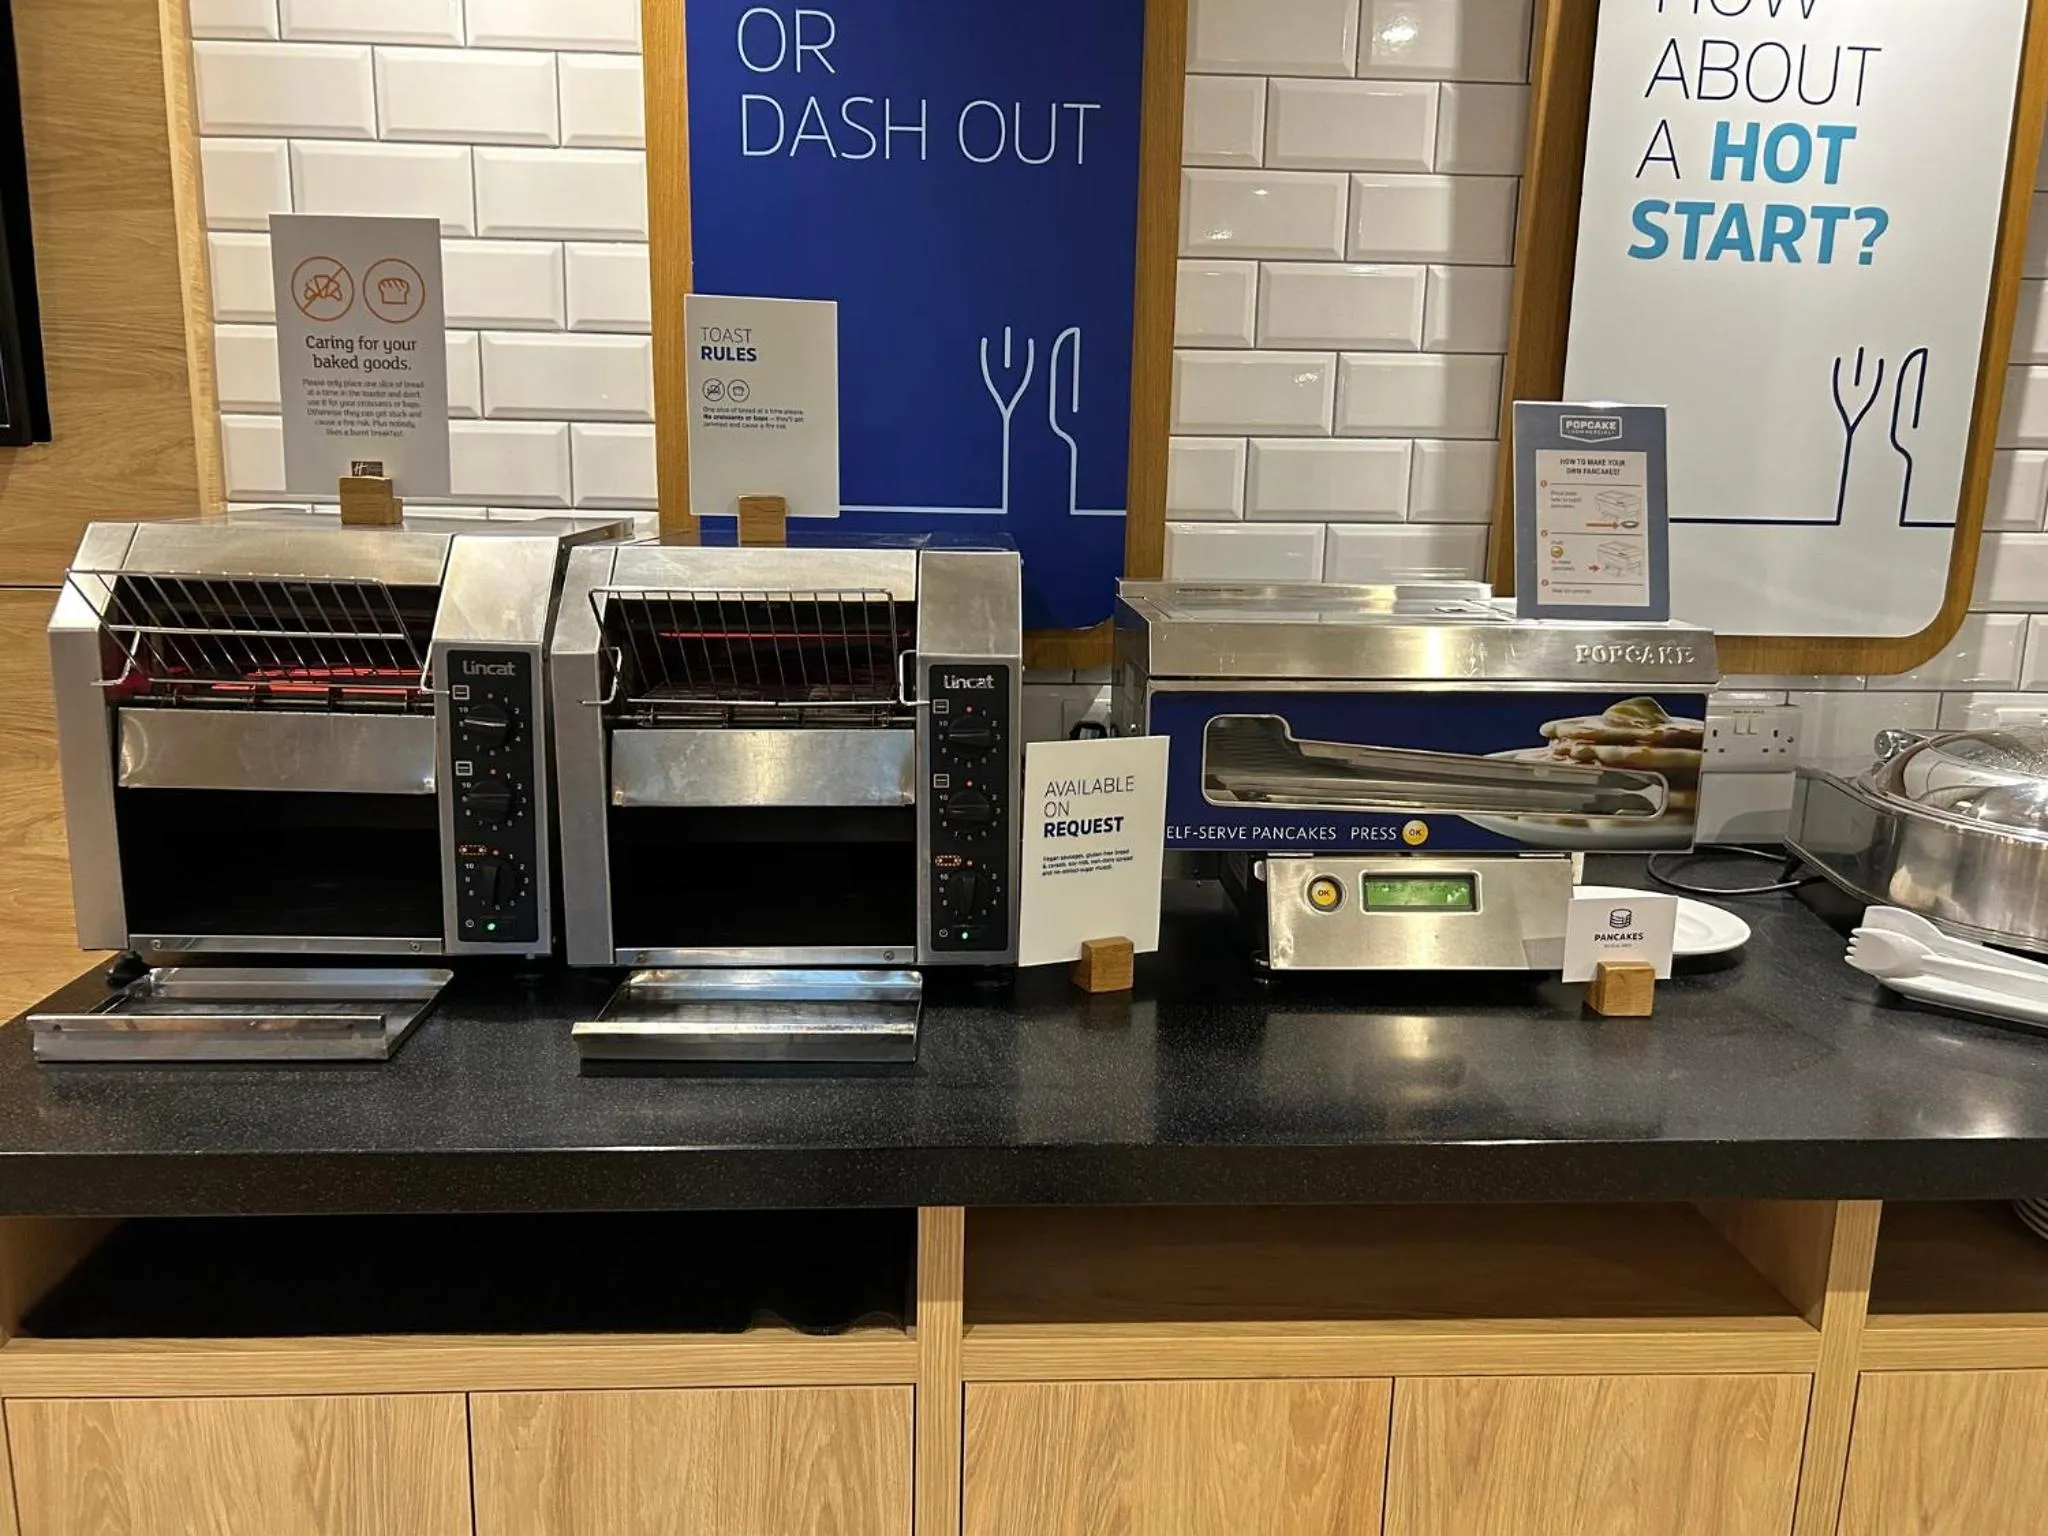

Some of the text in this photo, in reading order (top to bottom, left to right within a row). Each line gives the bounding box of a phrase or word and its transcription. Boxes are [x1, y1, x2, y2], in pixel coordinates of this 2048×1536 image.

[738, 7, 836, 74] OR
[1645, 38, 1882, 107] ABOUT
[742, 94, 1101, 165] DASH OUT
[1636, 119, 1857, 185] A HOT
[1627, 199, 1890, 266] START?
[700, 326, 752, 343] TOAST
[305, 335, 418, 354] Caring for your
[701, 345, 757, 362] RULES
[312, 353, 412, 373] baked goods.
[1565, 420, 1617, 430] POPCAKE
[1560, 458, 1575, 466] HOW
[1588, 459, 1606, 467] MAKE
[1608, 459, 1626, 467] YOUR
[1575, 644, 1695, 665] POPCAKE
[1045, 775, 1135, 798] AVAILABLE
[1044, 800, 1070, 818] ON
[1044, 816, 1124, 838] REQUEST
[1167, 825, 1248, 839] ELF-SERVE
[1252, 826, 1337, 840] PANCAKES
[1351, 826, 1397, 841] PRESS
[1317, 889, 1330, 897] OK
[1594, 932, 1645, 942] PANCAKES
